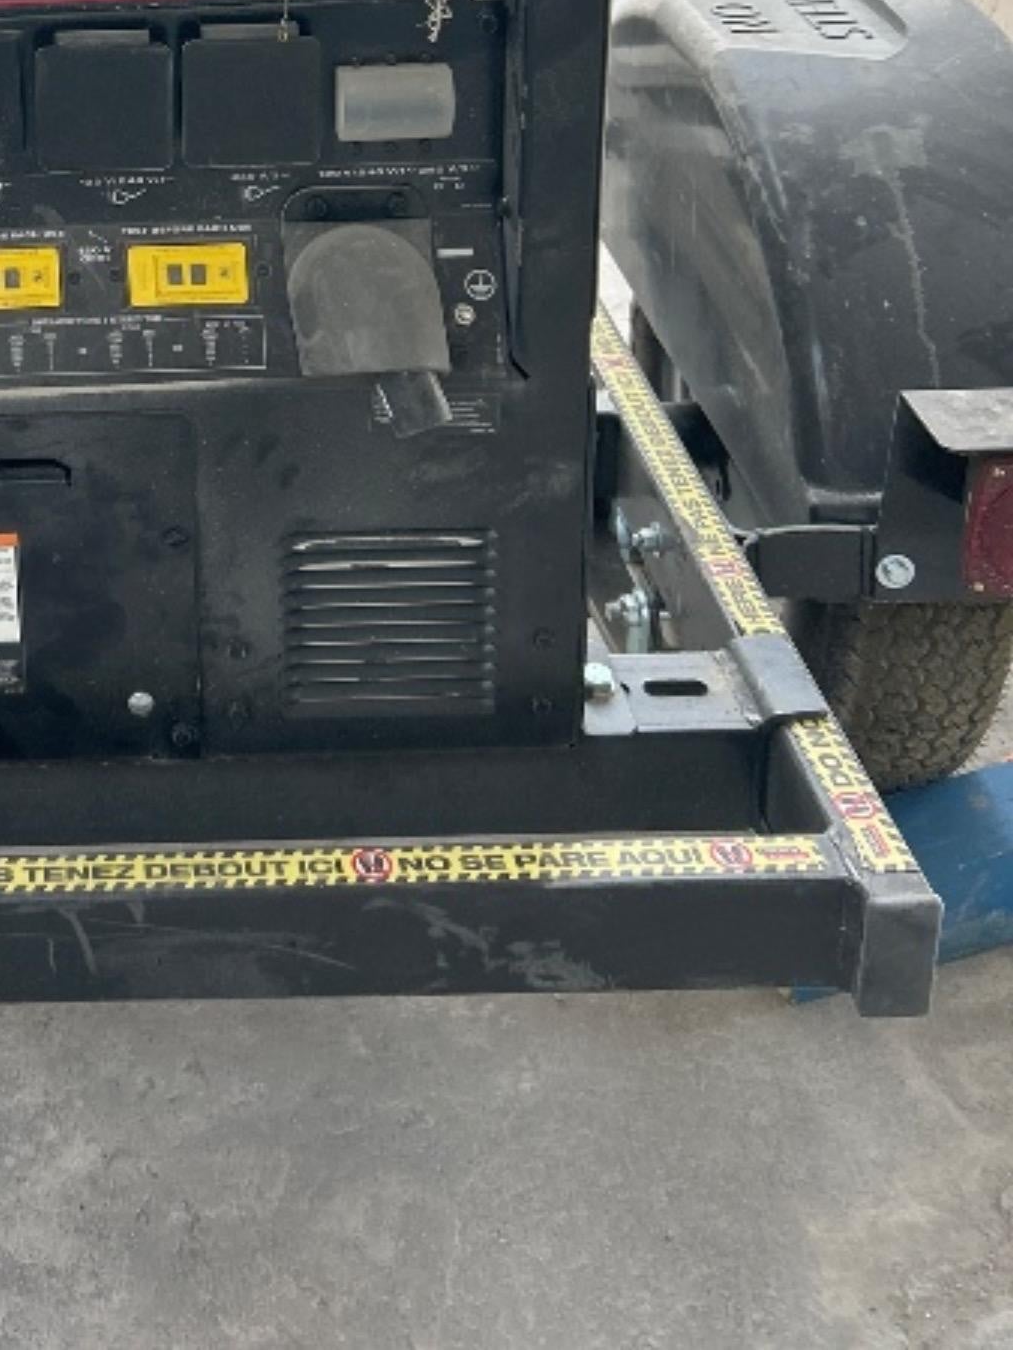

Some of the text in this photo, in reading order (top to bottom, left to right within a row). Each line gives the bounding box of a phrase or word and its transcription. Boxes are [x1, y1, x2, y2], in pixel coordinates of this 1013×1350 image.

[818, 753, 855, 786] DO
[22, 864, 136, 882] TENEZ
[145, 860, 293, 878] DEBOUT
[298, 857, 345, 874] ICI
[398, 847, 705, 871] NO SE PARE AQUI
